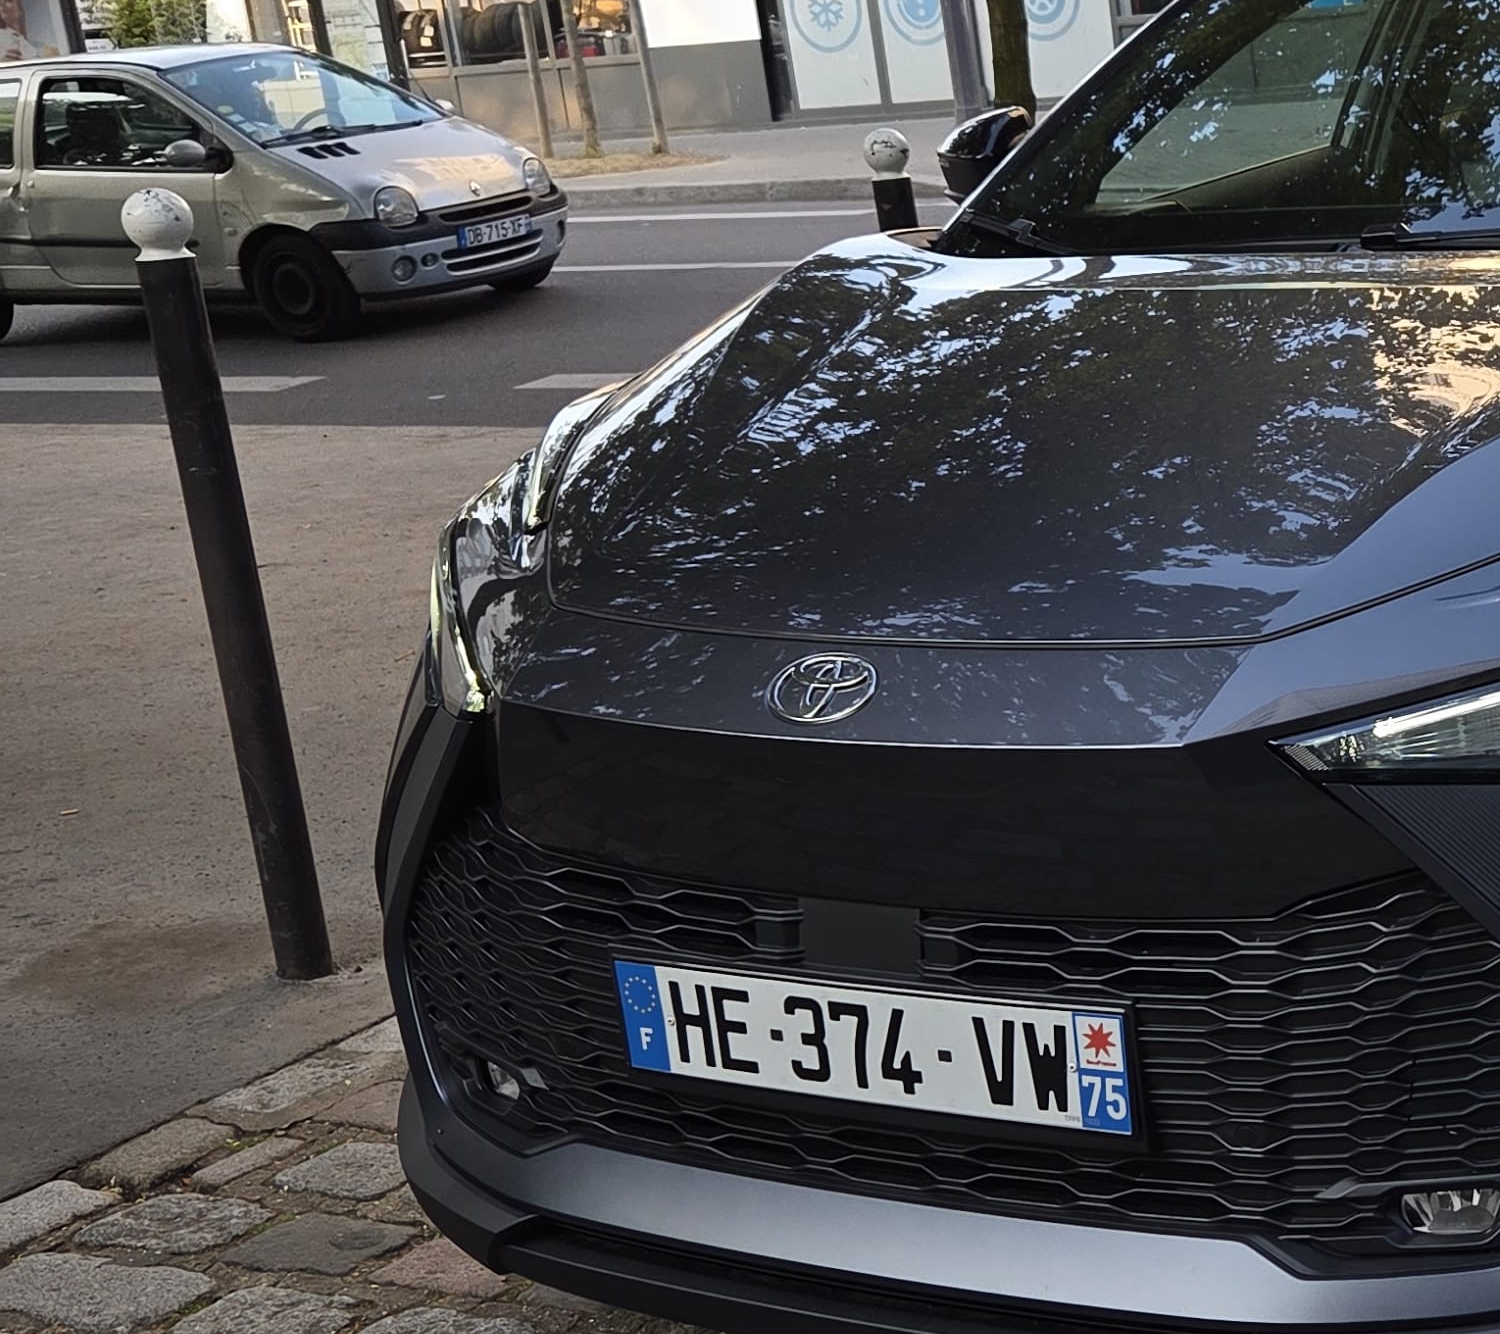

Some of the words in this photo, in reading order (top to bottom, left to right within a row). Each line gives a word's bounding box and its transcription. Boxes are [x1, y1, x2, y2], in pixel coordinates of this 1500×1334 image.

[467, 217, 523, 245] DB-715-XF
[639, 1027, 653, 1051] F
[668, 980, 1068, 1113] HE-374-VW
[1081, 1075, 1127, 1121] 75
